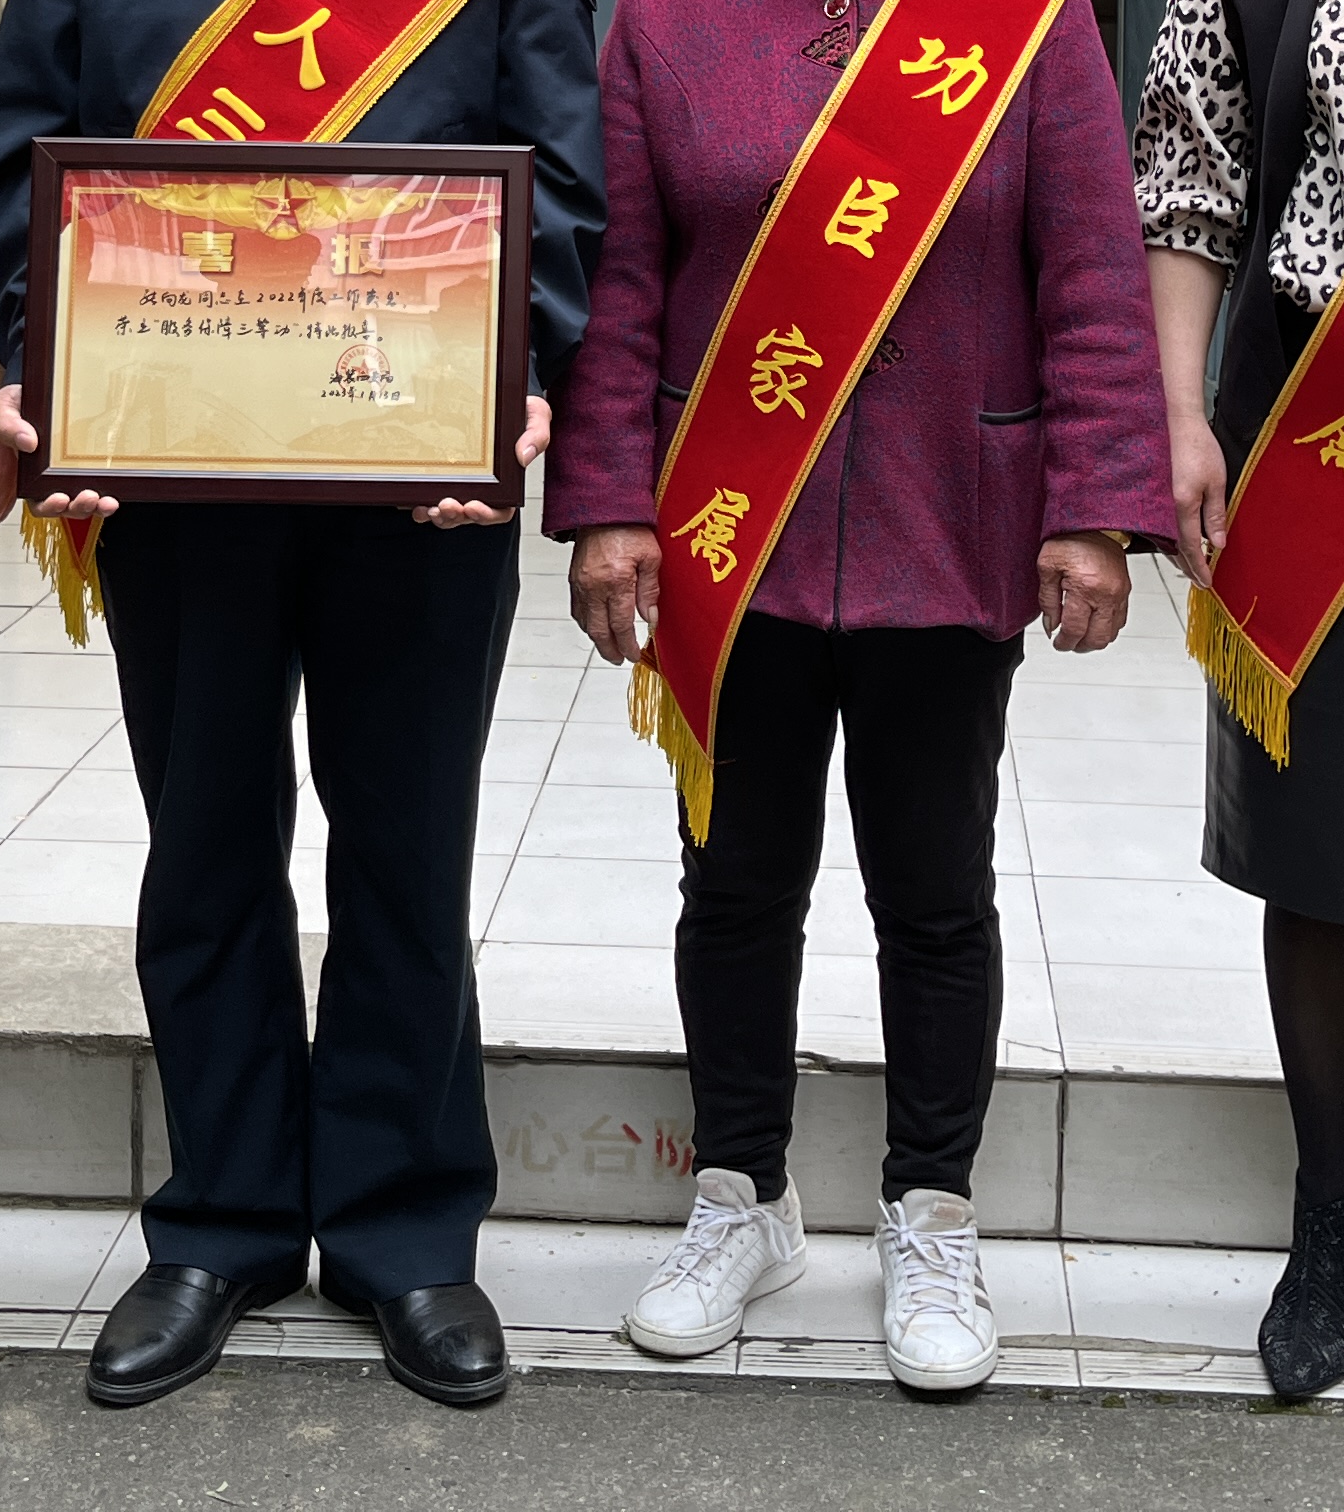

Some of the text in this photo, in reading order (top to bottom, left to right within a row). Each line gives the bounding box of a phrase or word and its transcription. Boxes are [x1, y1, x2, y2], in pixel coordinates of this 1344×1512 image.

[181, 230, 386, 276] 喜报
[670, 37, 989, 583] 功臣家属
